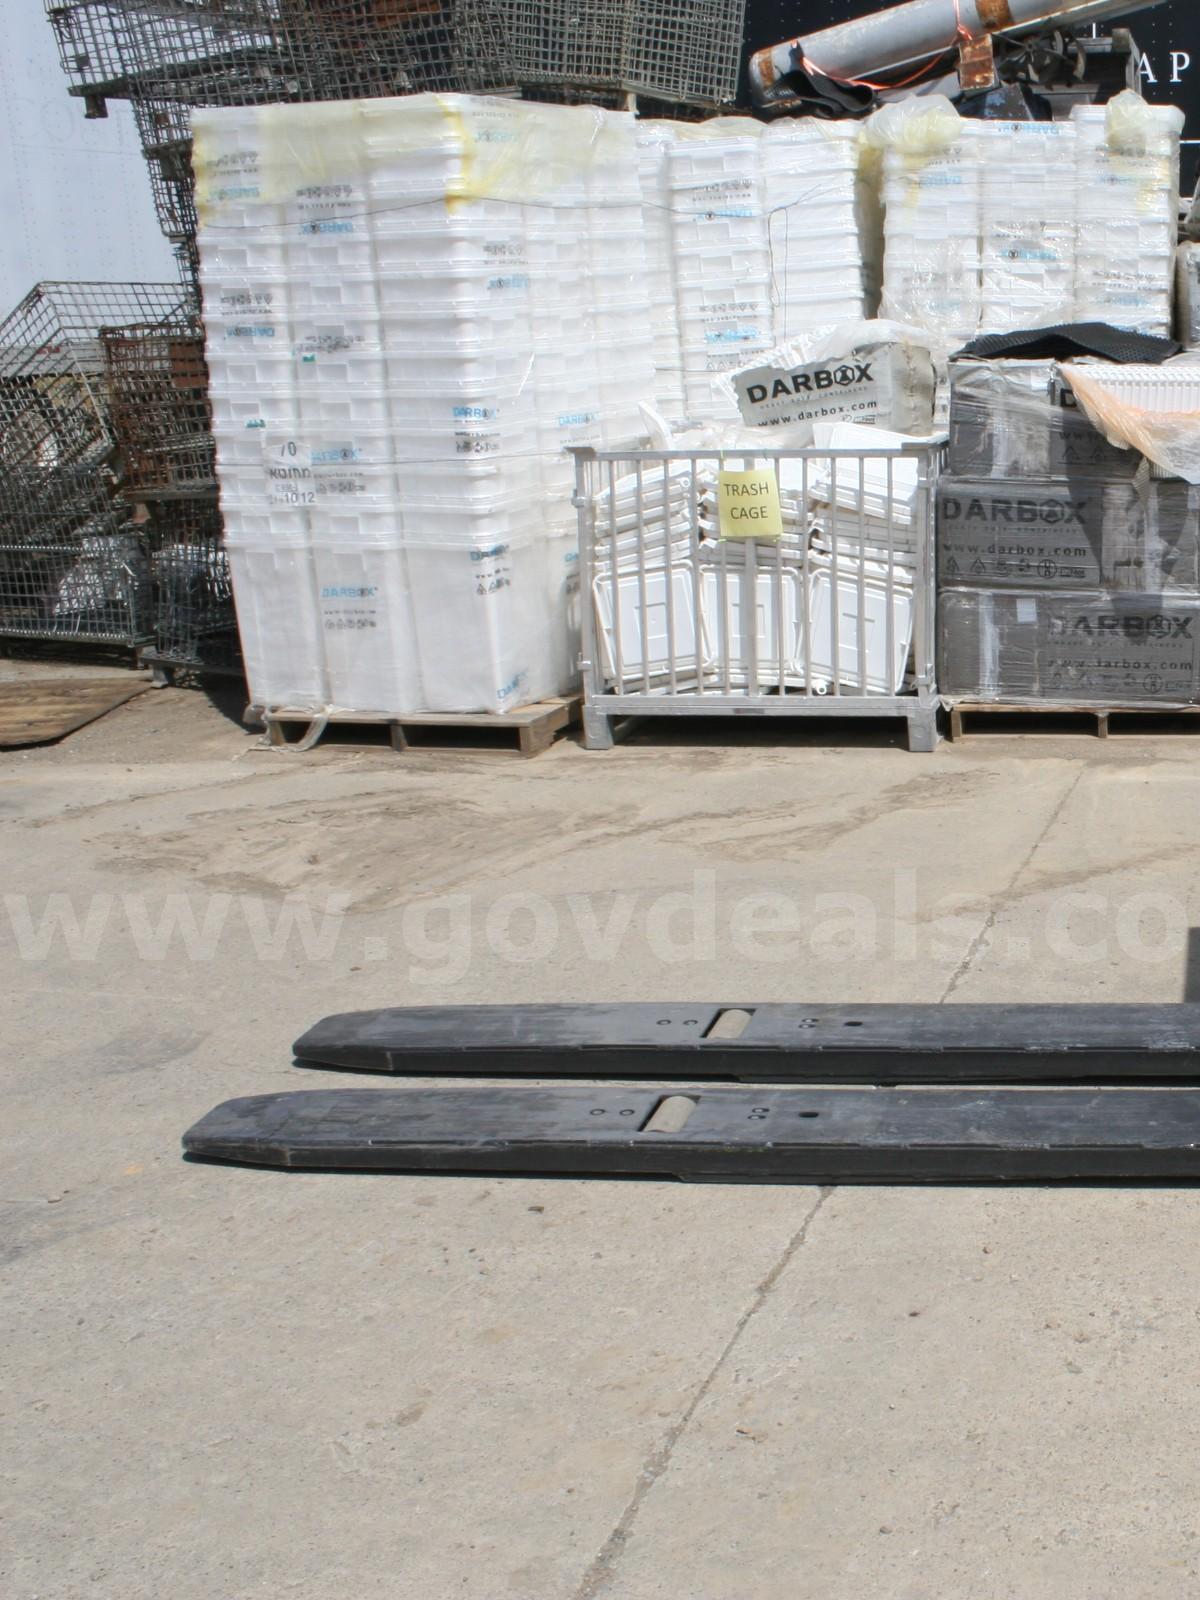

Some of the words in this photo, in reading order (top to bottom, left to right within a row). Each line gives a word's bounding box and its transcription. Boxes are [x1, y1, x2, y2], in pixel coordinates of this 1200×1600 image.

[746, 363, 874, 403] DARBOX
[758, 400, 878, 427] www.darbox.com
[723, 482, 769, 497] TRASH
[730, 505, 769, 520] CAGE
[943, 498, 1086, 524] DARBOX
